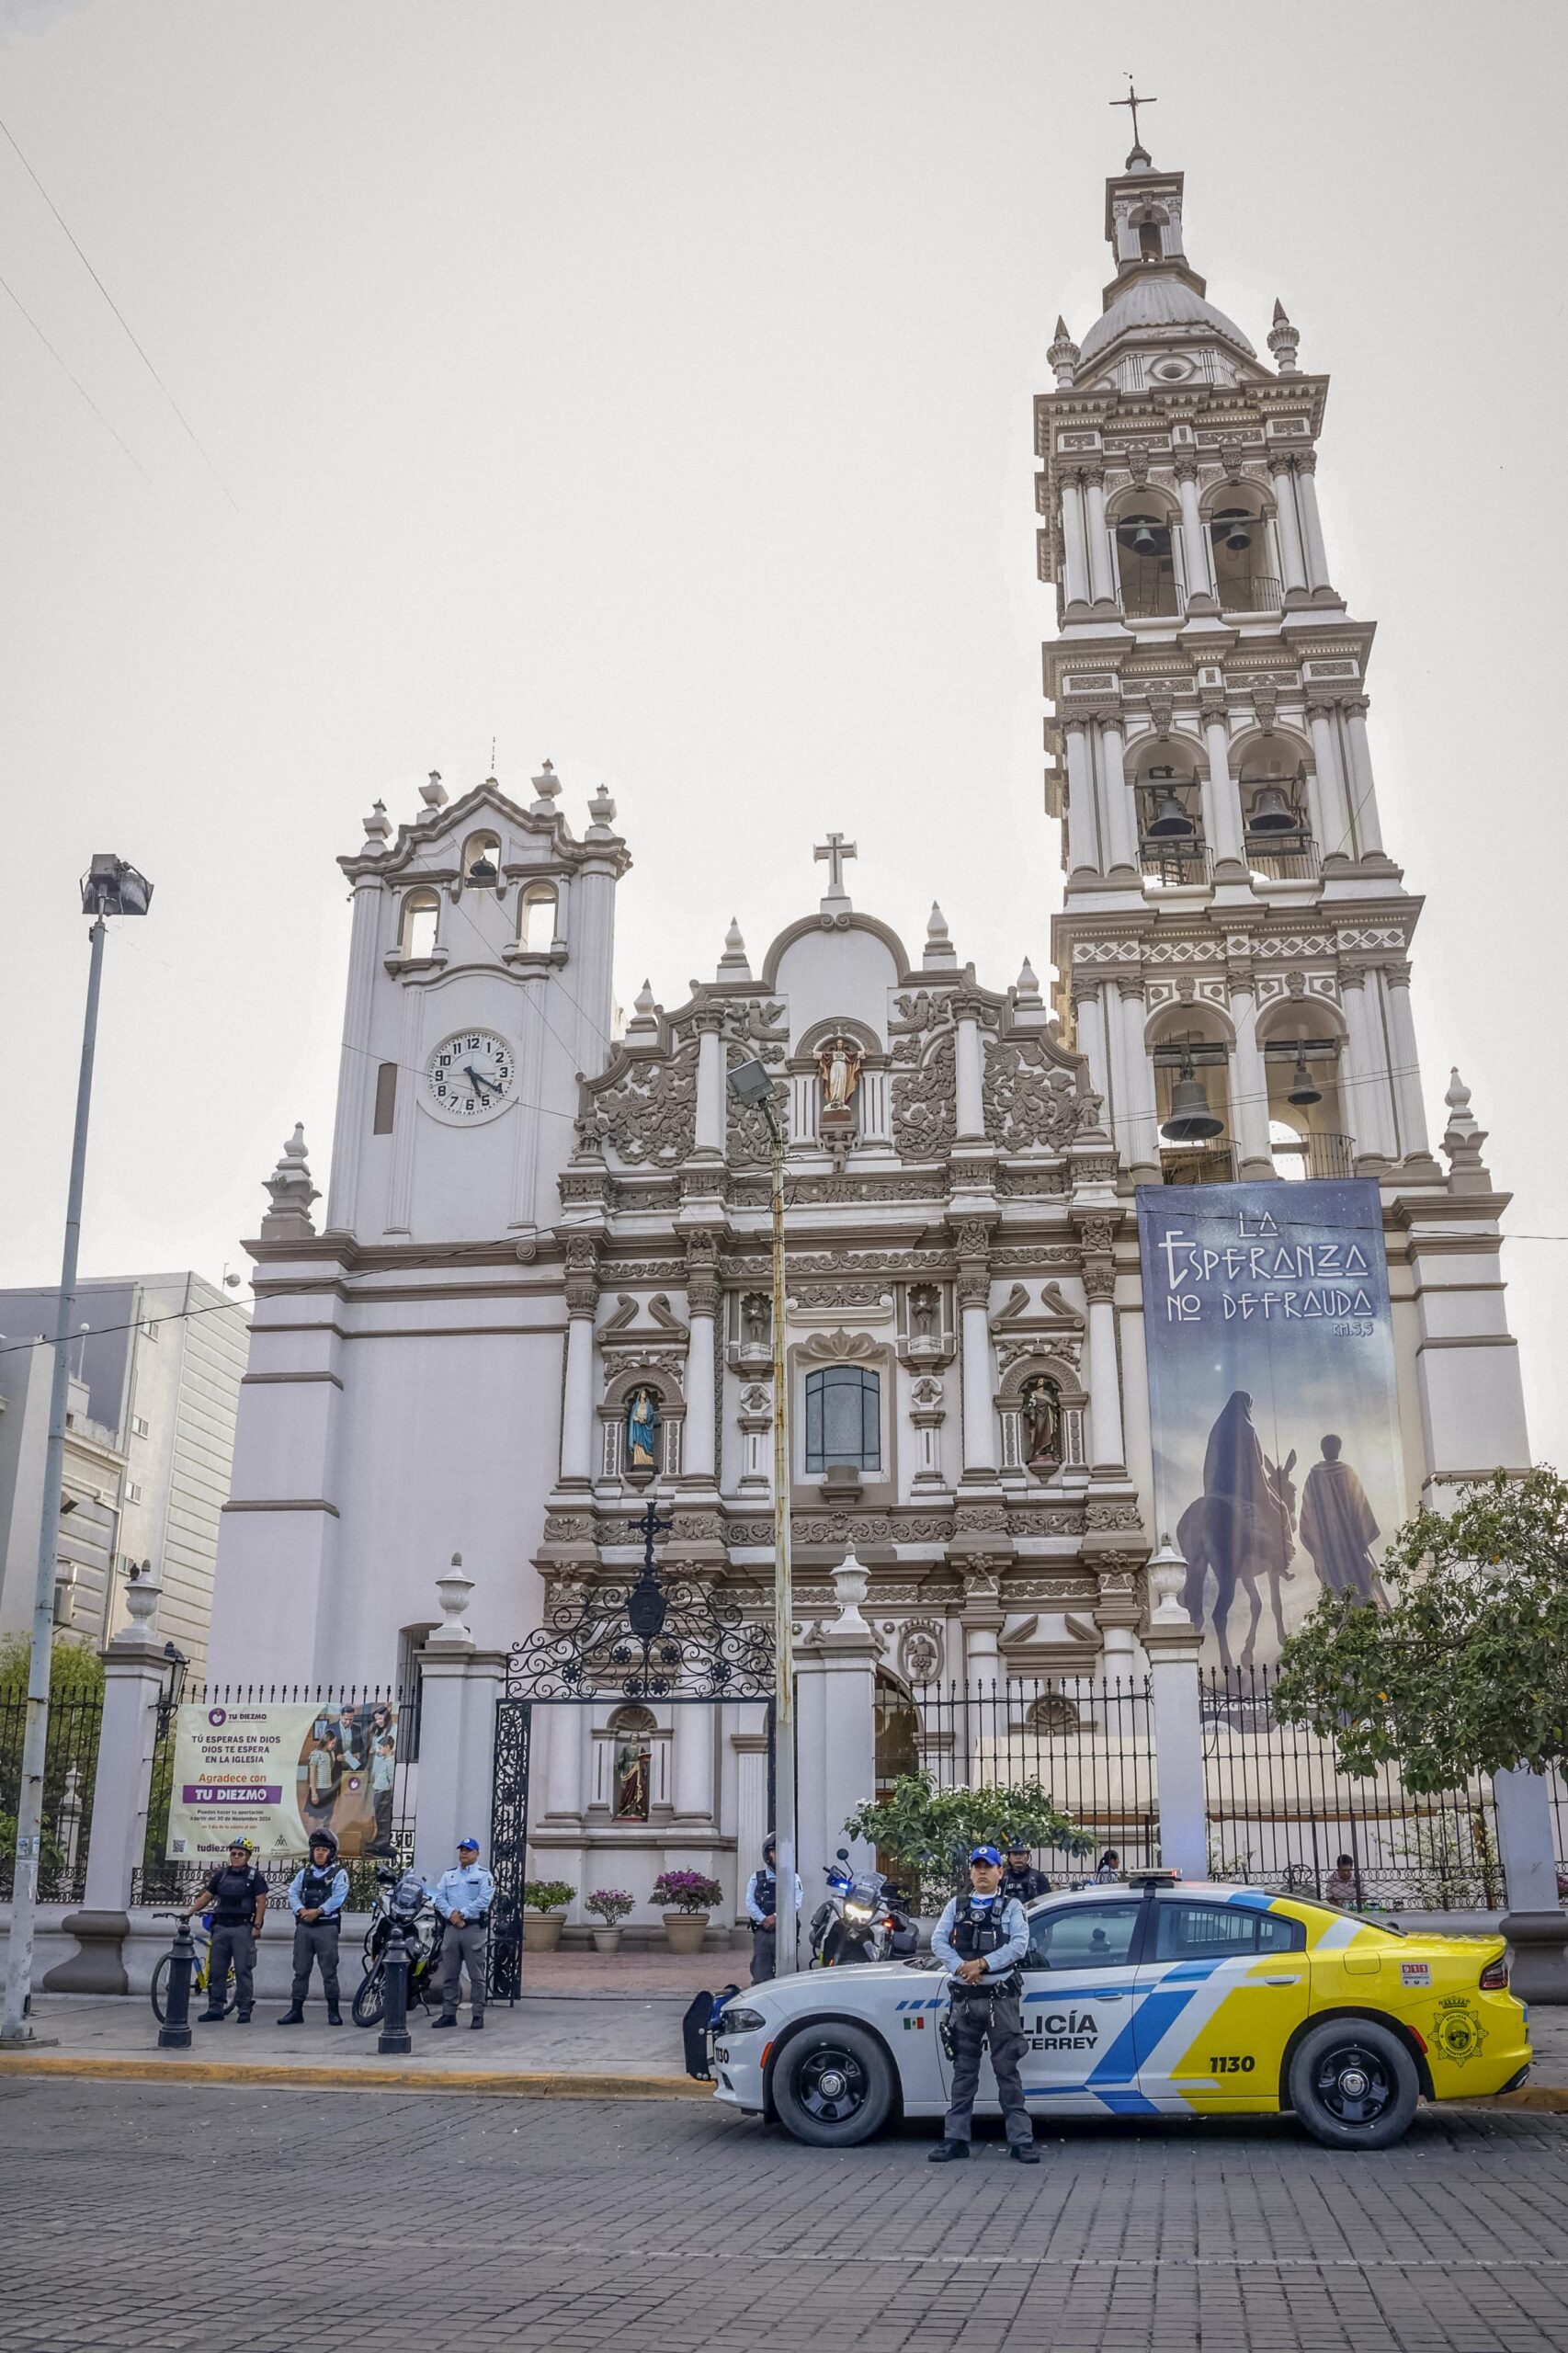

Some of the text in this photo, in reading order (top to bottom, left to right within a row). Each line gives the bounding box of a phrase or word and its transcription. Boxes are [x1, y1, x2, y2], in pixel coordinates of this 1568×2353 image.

[452, 1042, 461, 1054] 11
[467, 1038, 480, 1050] 12
[487, 1041, 492, 1053] 1
[439, 1054, 451, 1066] 10
[495, 1051, 505, 1063] 2
[435, 1070, 443, 1082] 9
[499, 1066, 508, 1078] 3
[437, 1086, 447, 1097] 8
[495, 1083, 504, 1094] 4
[449, 1096, 459, 1108] 7
[466, 1099, 475, 1110] 6
[482, 1094, 490, 1107] 5
[1239, 1211, 1278, 1238] LA
[1167, 1289, 1373, 1322] NO DEFRAUDA
[191, 1734, 204, 1743] TÚ
[237, 1745, 270, 1754] ESPERA
[232, 1756, 264, 1764] IGLESIA
[199, 1773, 267, 1783] Agradece con
[195, 1789, 267, 1801] TU DIEZMO
[1021, 2009, 1098, 2035] LICÍA
[1210, 2055, 1256, 2074] 1130
